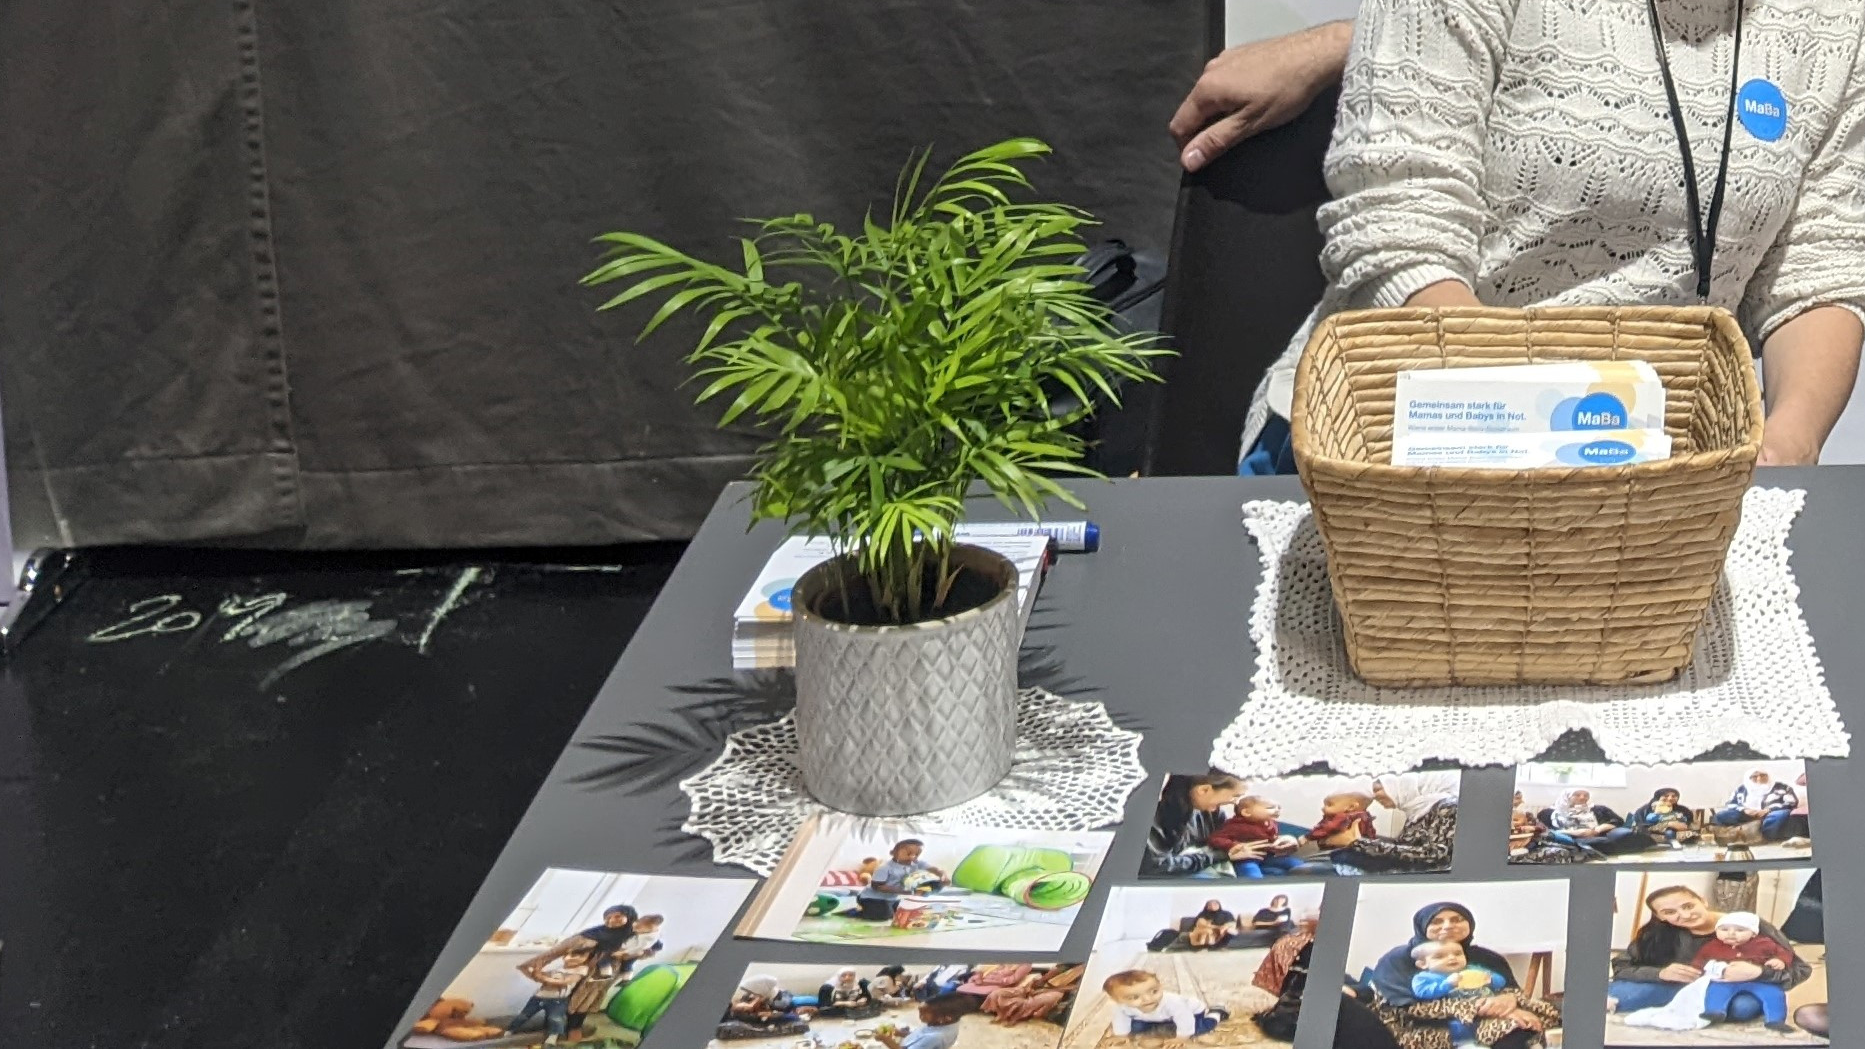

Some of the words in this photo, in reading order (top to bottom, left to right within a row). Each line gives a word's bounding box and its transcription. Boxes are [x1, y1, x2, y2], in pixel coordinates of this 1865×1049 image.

[1744, 99, 1780, 118] MaBa
[1409, 399, 1465, 410] Gemeinsam
[1408, 410, 1443, 419] Mamas
[1445, 411, 1463, 420] und
[1577, 411, 1620, 426] MaBa
